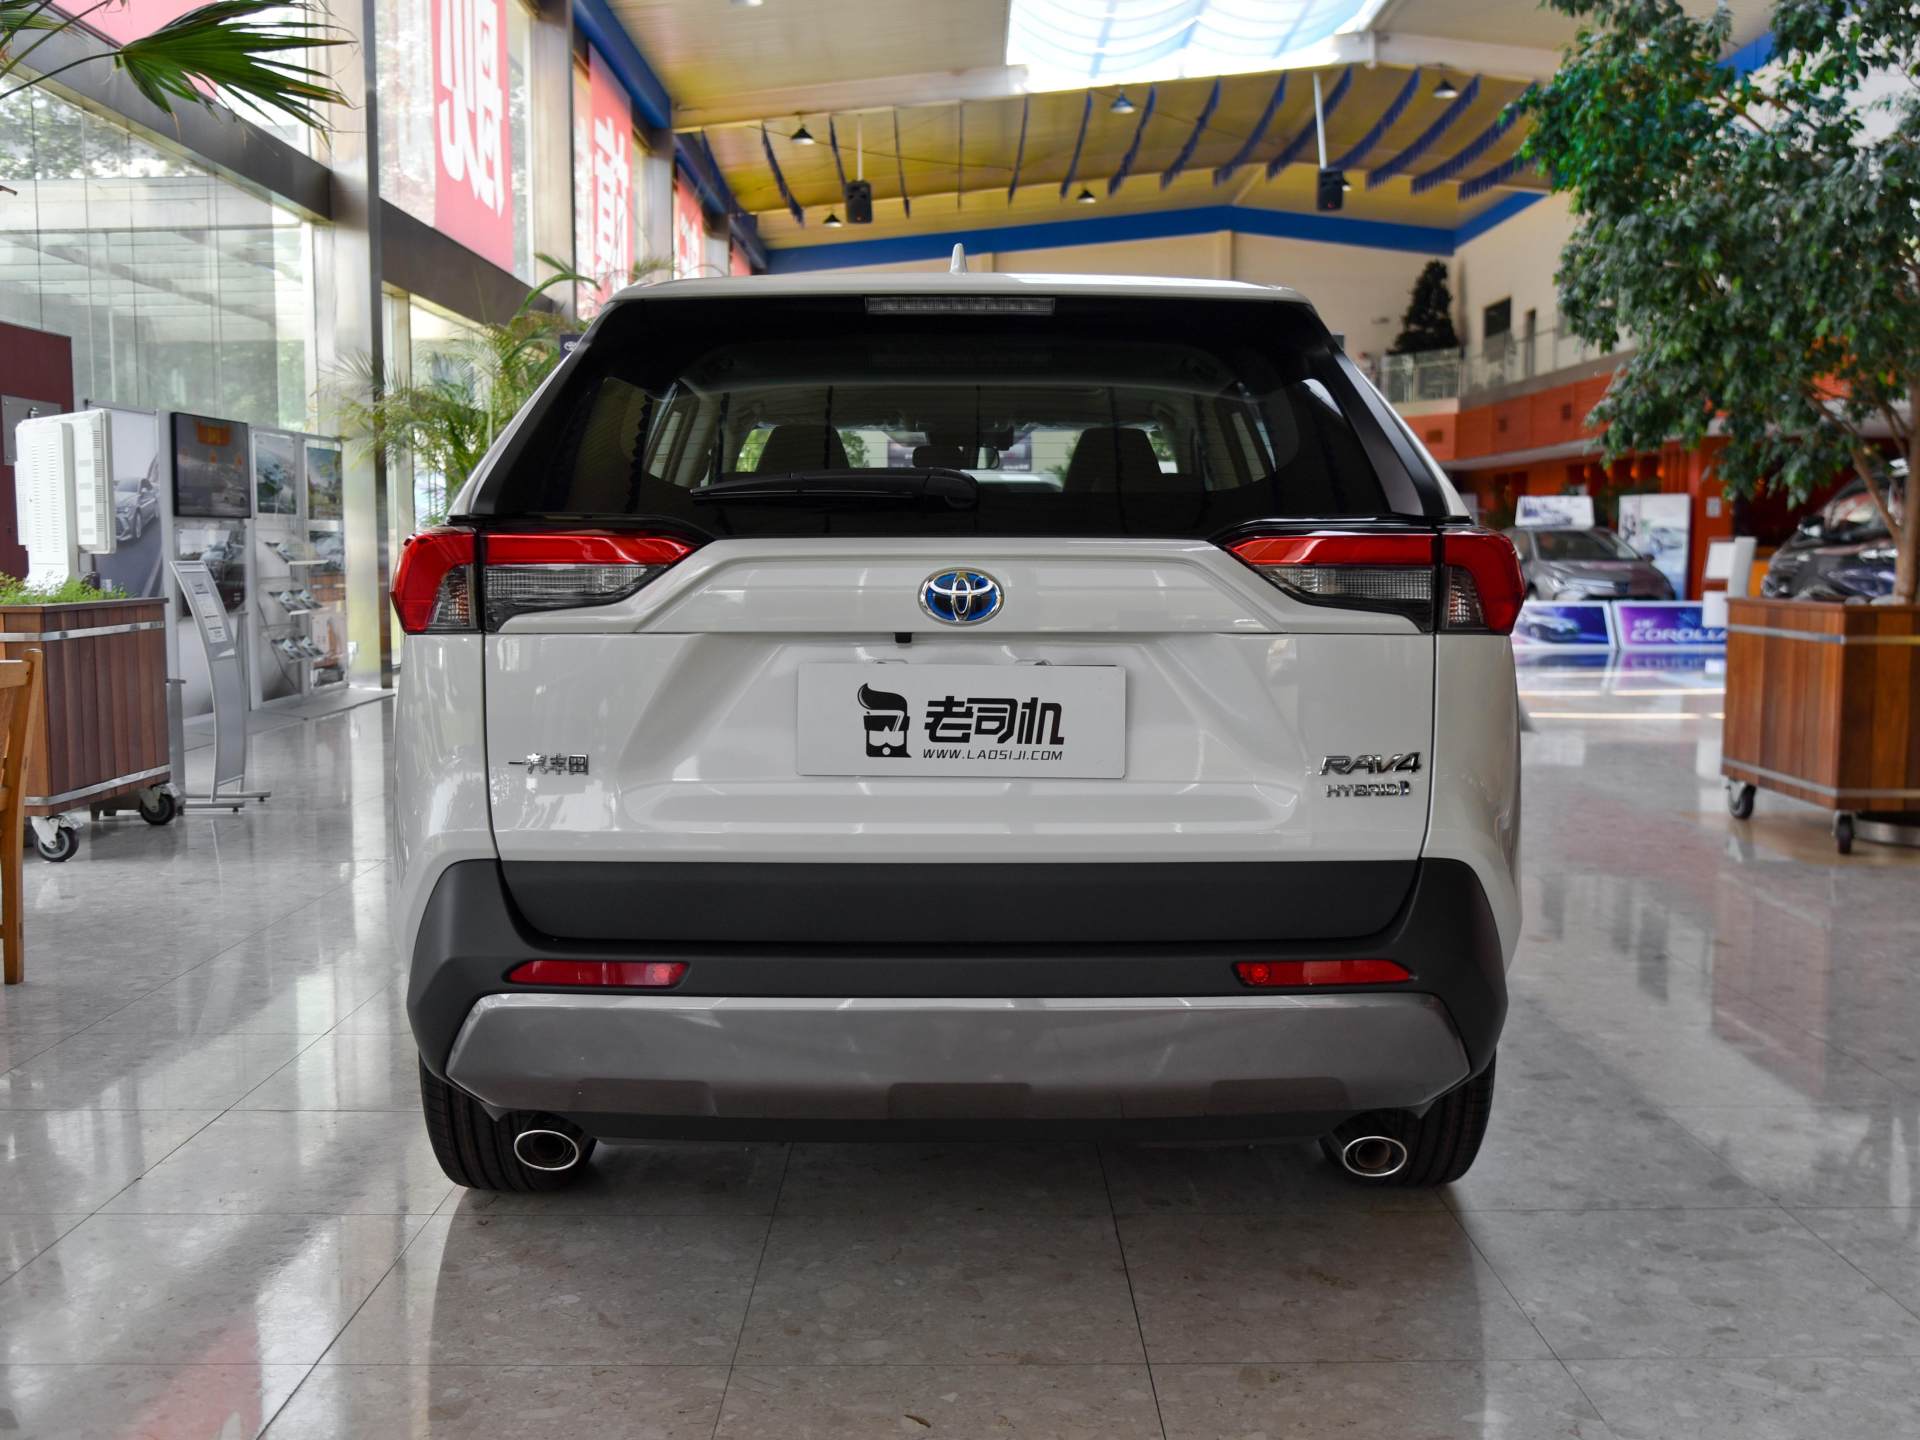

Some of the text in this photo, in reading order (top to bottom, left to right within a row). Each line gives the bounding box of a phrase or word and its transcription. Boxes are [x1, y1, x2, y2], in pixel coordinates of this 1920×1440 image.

[924, 695, 1065, 745] 老司机
[922, 748, 1063, 761] WWW.LAOSIJI.COM
[1319, 752, 1421, 775] RAV4
